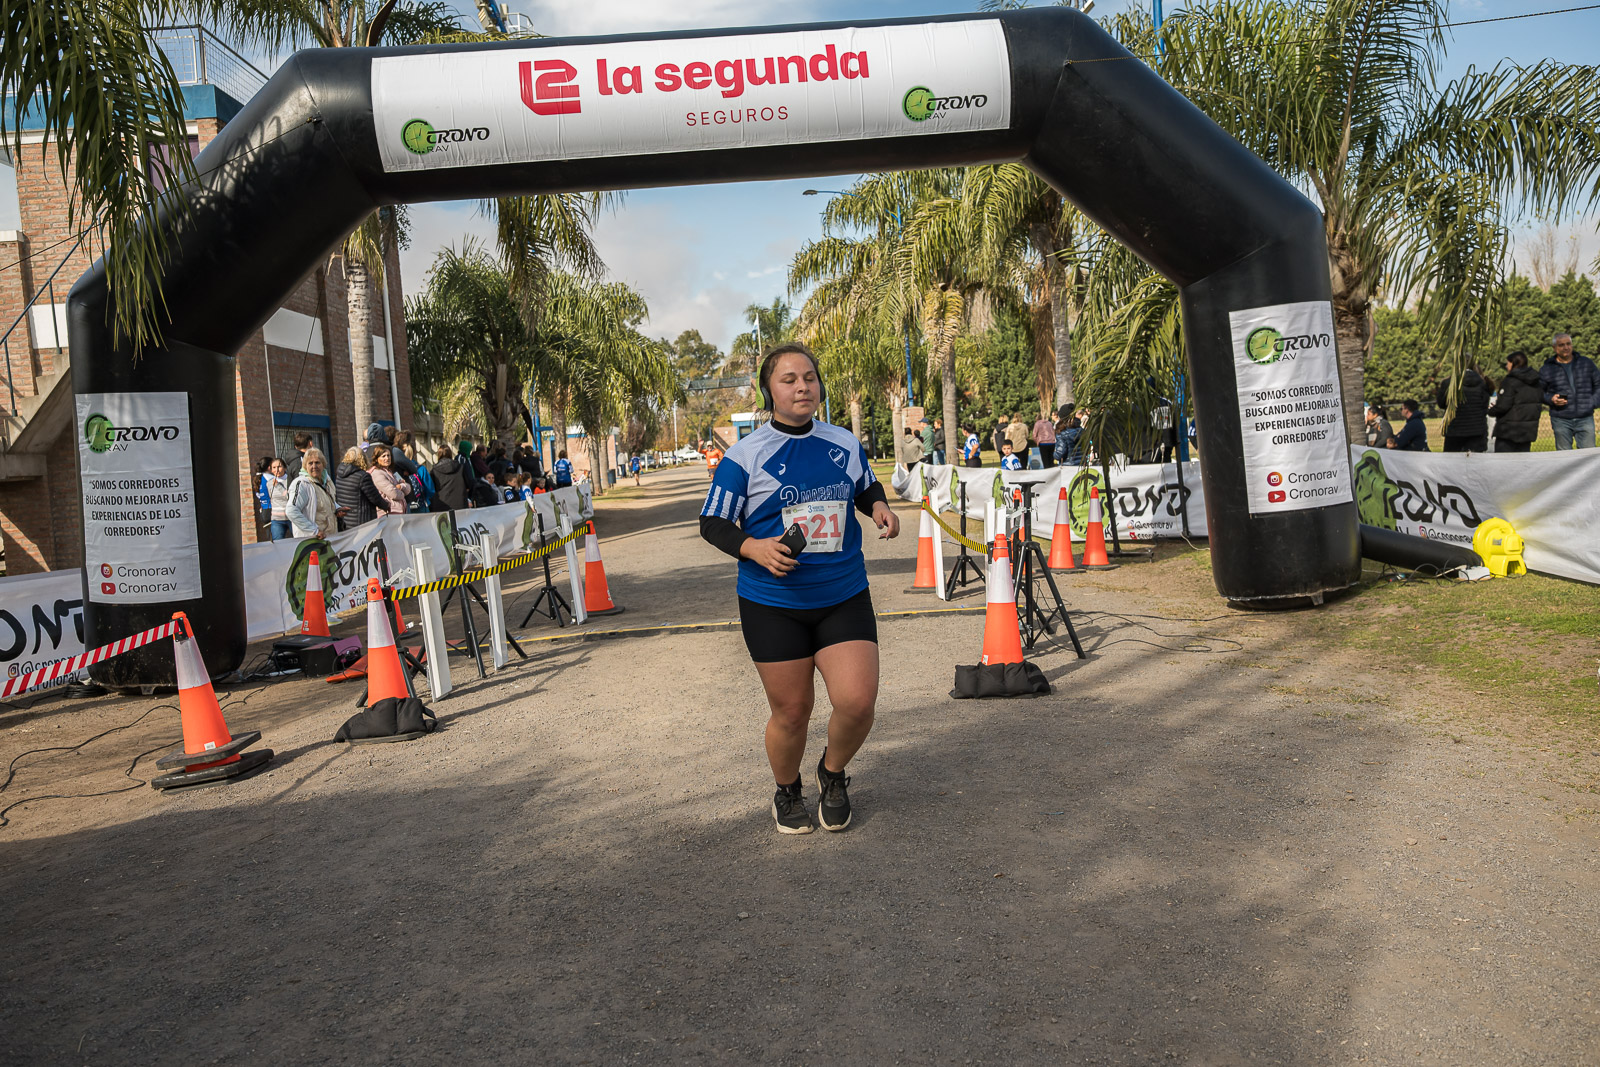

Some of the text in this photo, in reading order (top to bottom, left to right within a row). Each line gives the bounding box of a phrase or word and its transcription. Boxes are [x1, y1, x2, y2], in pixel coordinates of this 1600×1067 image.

[596, 58, 643, 96] la
[654, 44, 870, 99] segunda
[925, 94, 988, 111] CRONO
[686, 105, 789, 127] SEGUROS
[924, 112, 947, 121] RAV
[426, 127, 490, 144] CRONO
[426, 144, 449, 153] RAV
[1273, 333, 1330, 352] CRONO
[1272, 352, 1297, 362] RAV
[1288, 384, 1334, 398] CORREDORES
[1245, 398, 1339, 418] BUSCANDO MEJORAR LAS
[1255, 413, 1336, 432] EXPERIENCIAS DE LOS
[104, 426, 180, 442] CRONO
[104, 443, 129, 452] RAV
[118, 478, 180, 490] CORREDORES
[1288, 470, 1338, 484] Cronorav
[85, 492, 189, 506] BUSCANDO MEJORAR LAS
[1289, 485, 1339, 500] Cronorav
[91, 509, 181, 521] EXPERIENCIAS DE LOS
[793, 513, 842, 539] 521
[117, 565, 176, 578] Cronorav
[118, 581, 178, 594] Cronorav
